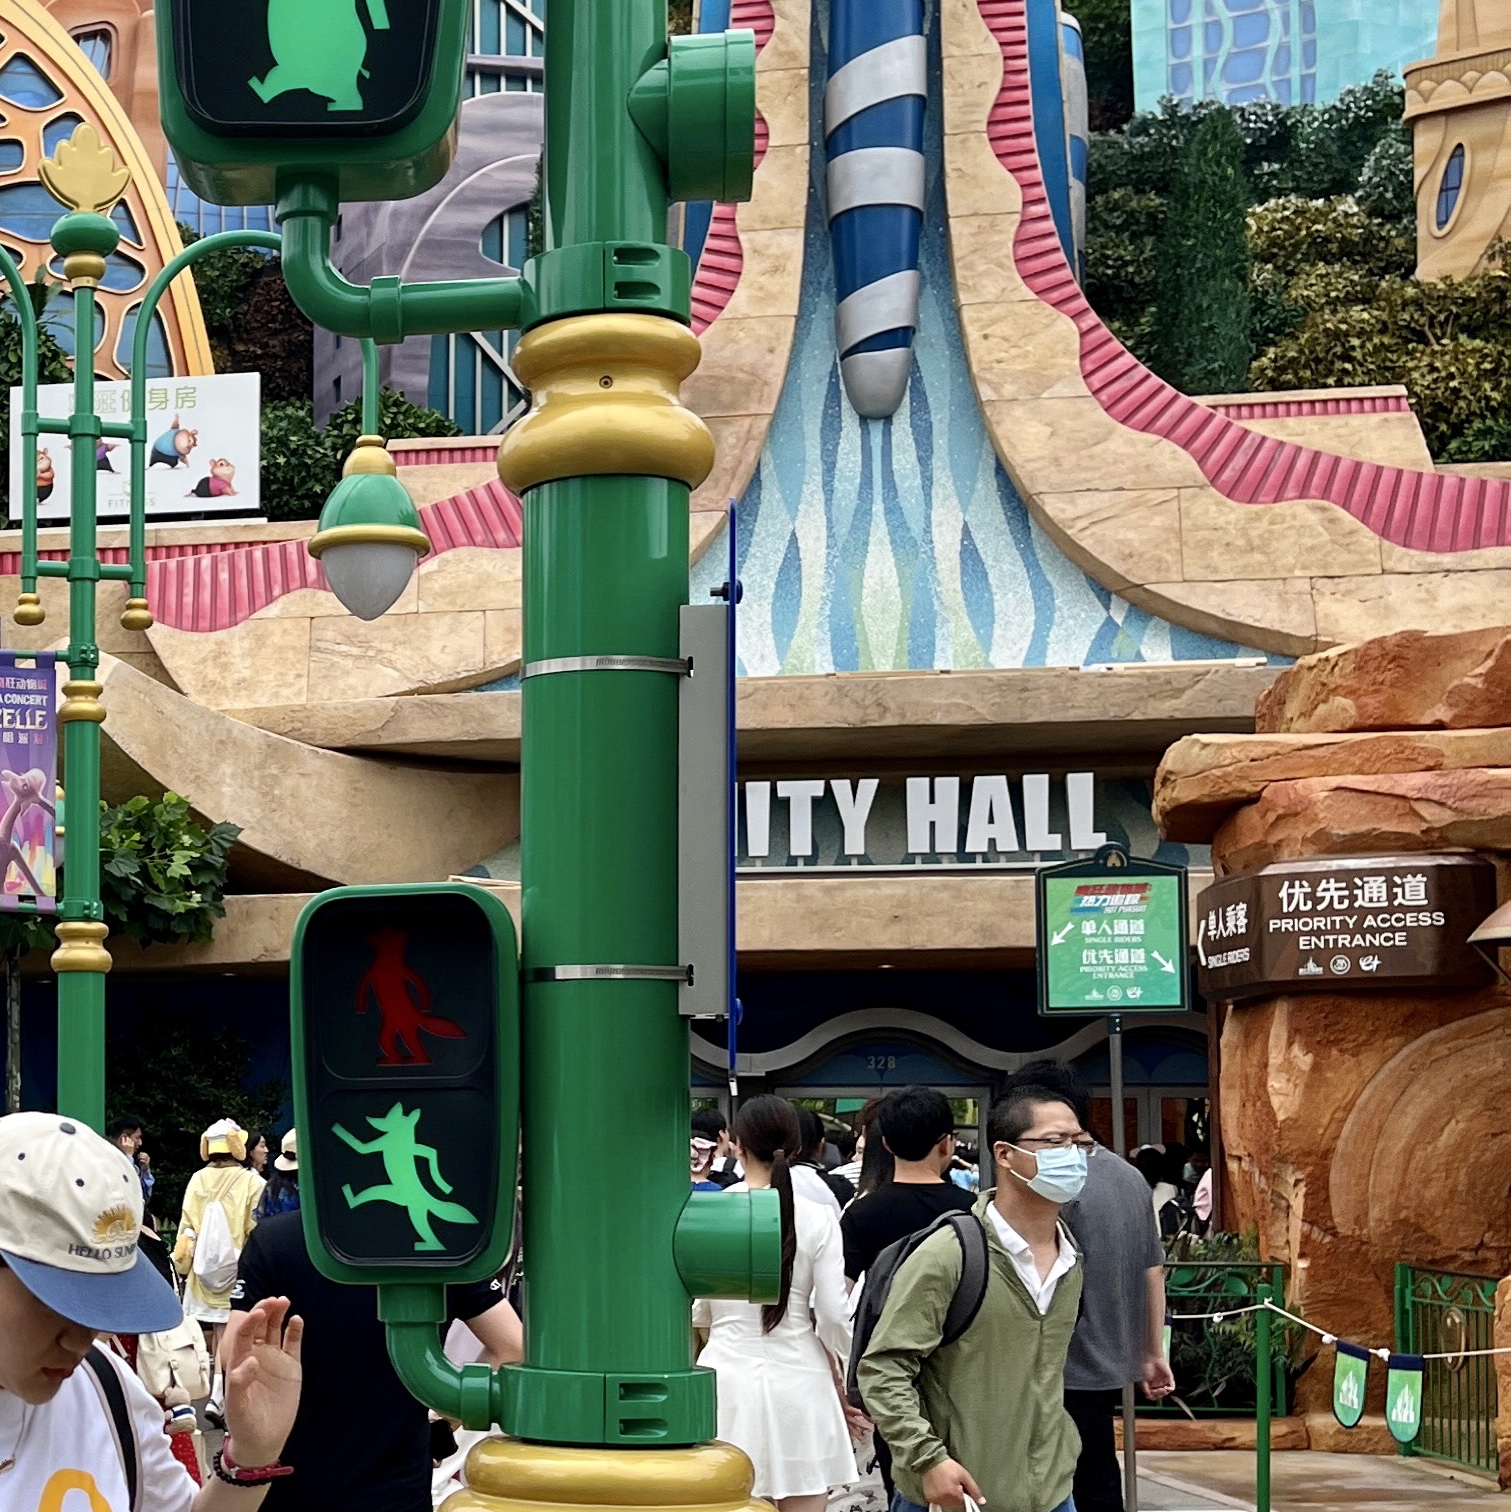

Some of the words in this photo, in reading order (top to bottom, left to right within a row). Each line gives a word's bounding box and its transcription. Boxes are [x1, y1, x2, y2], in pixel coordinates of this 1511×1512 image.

[4, 693, 48, 706] CONCERT
[735, 779, 879, 857] ITY
[905, 772, 1107, 854] HALL
[1278, 873, 1429, 913] 优先通道
[1081, 919, 1145, 935] 单人通道
[1207, 901, 1249, 941] 单人乘客
[1268, 915, 1358, 933] PRIORITY
[1363, 911, 1445, 928] ACCESS
[1299, 931, 1407, 950] ENTRANCE
[1082, 948, 1145, 964] 优先通道
[867, 1055, 896, 1069] 328
